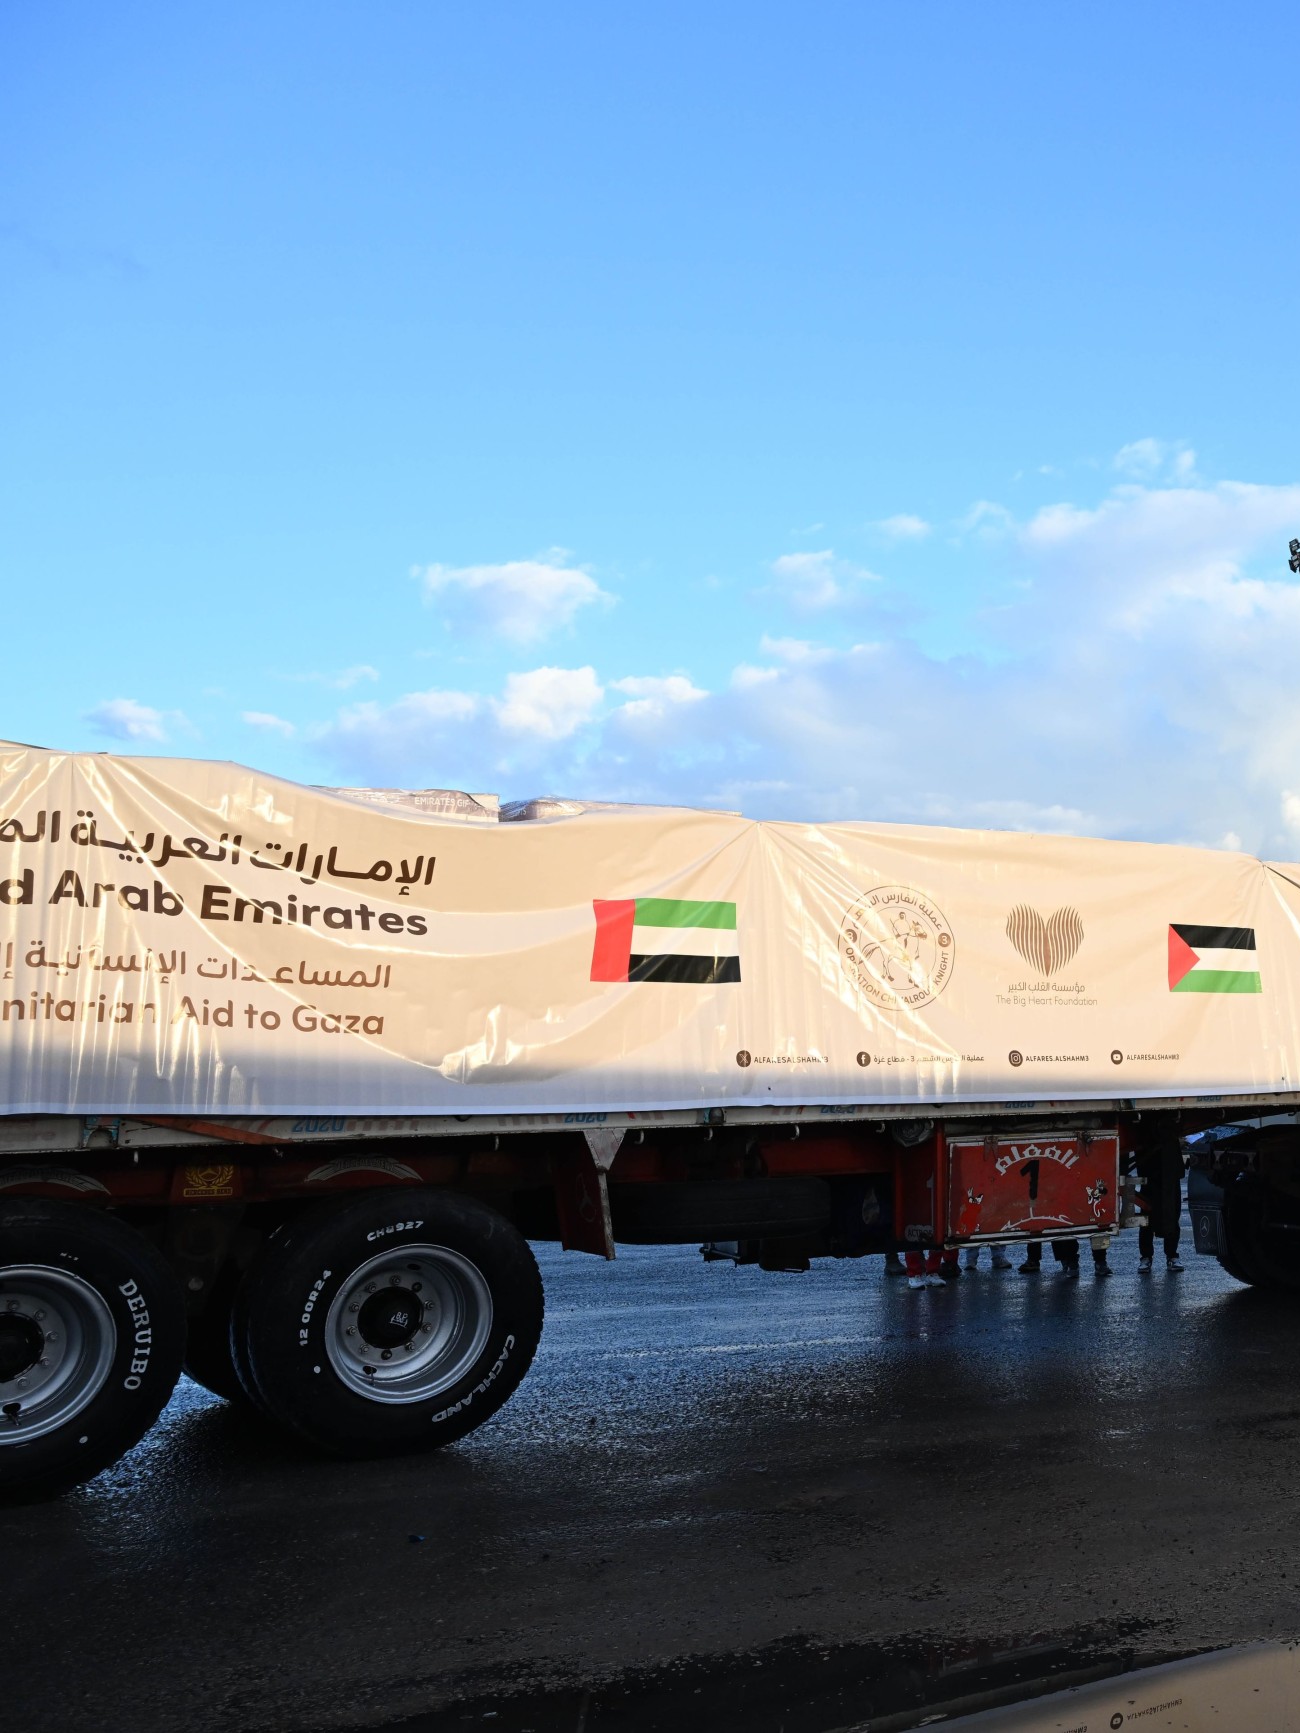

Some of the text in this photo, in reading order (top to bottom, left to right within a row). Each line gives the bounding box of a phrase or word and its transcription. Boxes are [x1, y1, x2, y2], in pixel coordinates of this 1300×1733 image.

[414, 797, 456, 806] EMIRATES
[70, 809, 242, 867] العربية
[250, 843, 436, 896] الإمارات
[0, 868, 428, 936] d Arab Emirates
[882, 893, 918, 906] الفارس
[918, 901, 942, 930] عملية
[25, 940, 186, 984] الإنسانية
[196, 956, 391, 989] المساعدات
[933, 951, 949, 986] KNIGHT
[996, 995, 1098, 1007] The Big Heart Foundation
[1008, 981, 1086, 994] مؤسسة القلب الكبير
[2, 990, 384, 1036] nitarian Aid to Gaza
[873, 1055, 886, 1065] غزة
[966, 1054, 985, 1062] عملية
[291, 1116, 347, 1133] 2020
[119, 1278, 152, 1391] DERUIBO
[431, 1334, 516, 1423] CACHLAND
